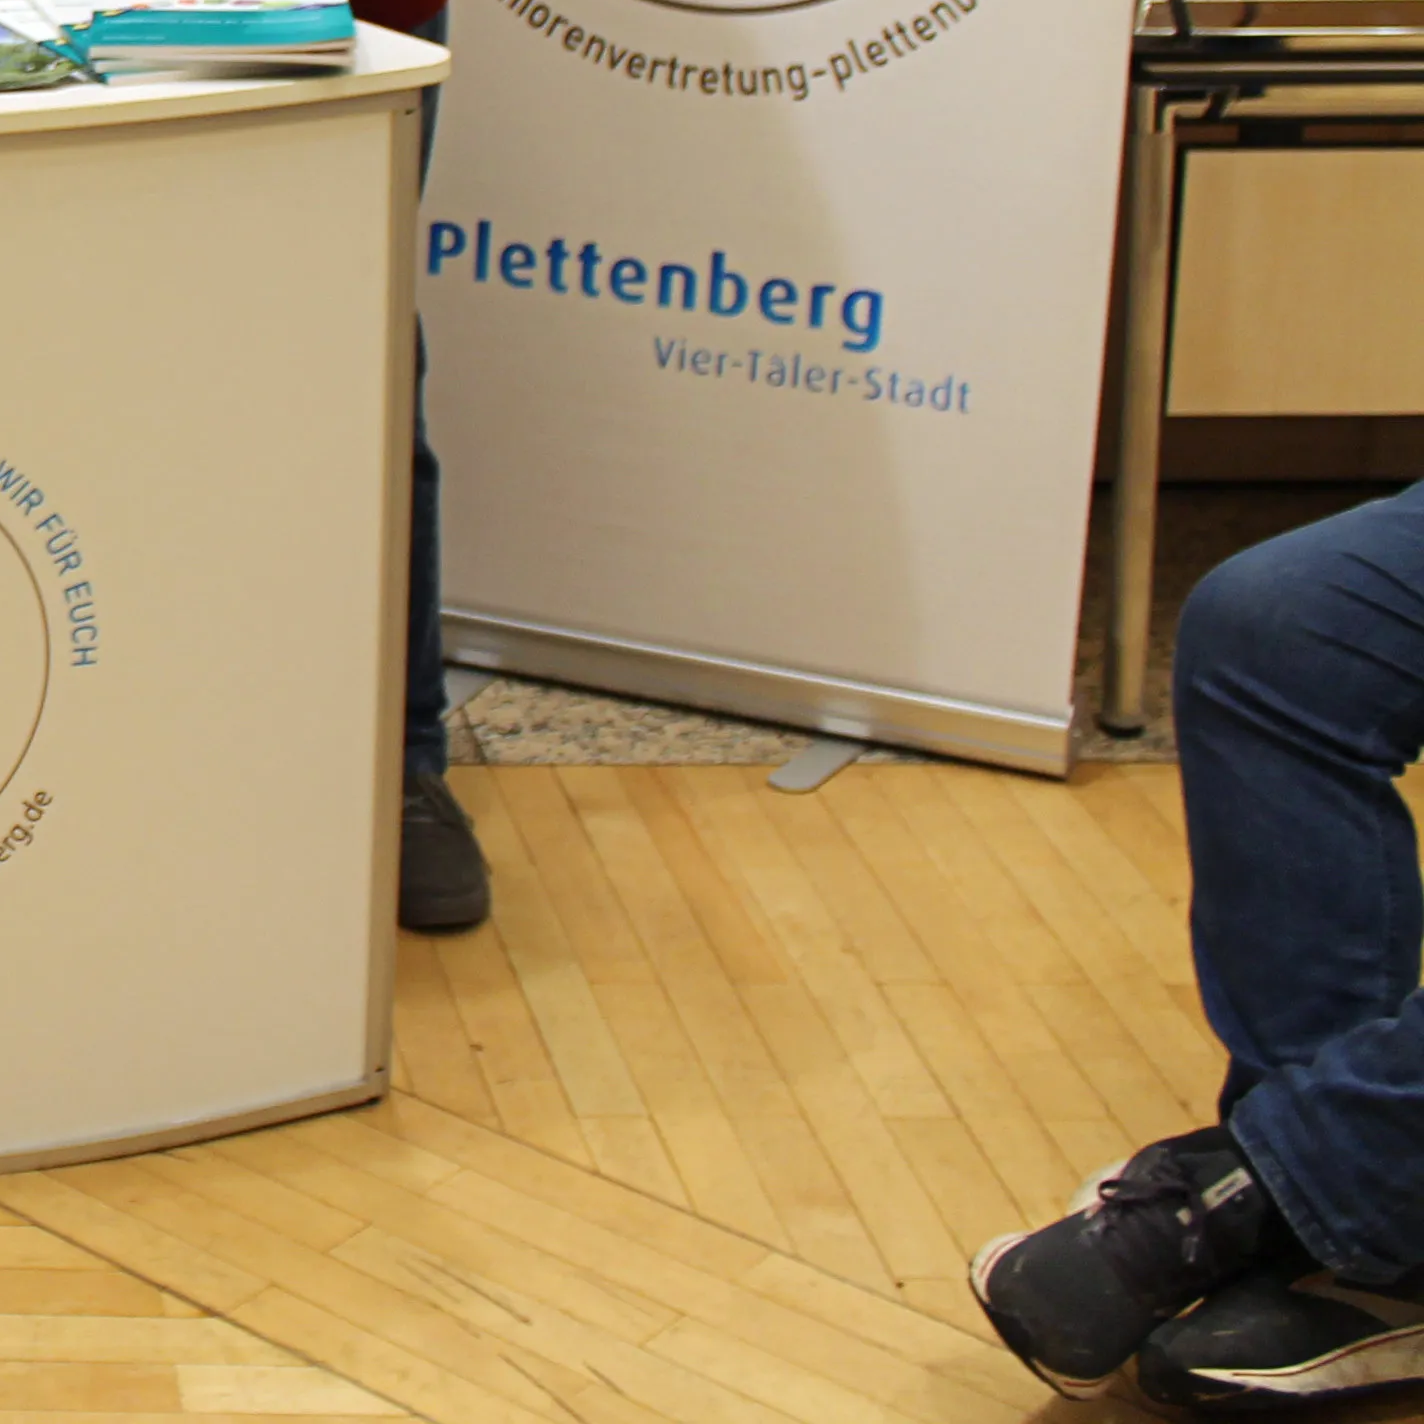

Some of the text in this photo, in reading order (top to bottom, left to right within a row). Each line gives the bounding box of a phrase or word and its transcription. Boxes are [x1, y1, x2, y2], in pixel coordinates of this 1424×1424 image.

[427, 219, 884, 353] Plettenberg
[652, 336, 973, 414] Vier-Täler-Stadt
[35, 512, 83, 578] FÜR
[63, 580, 98, 667] EUCH
